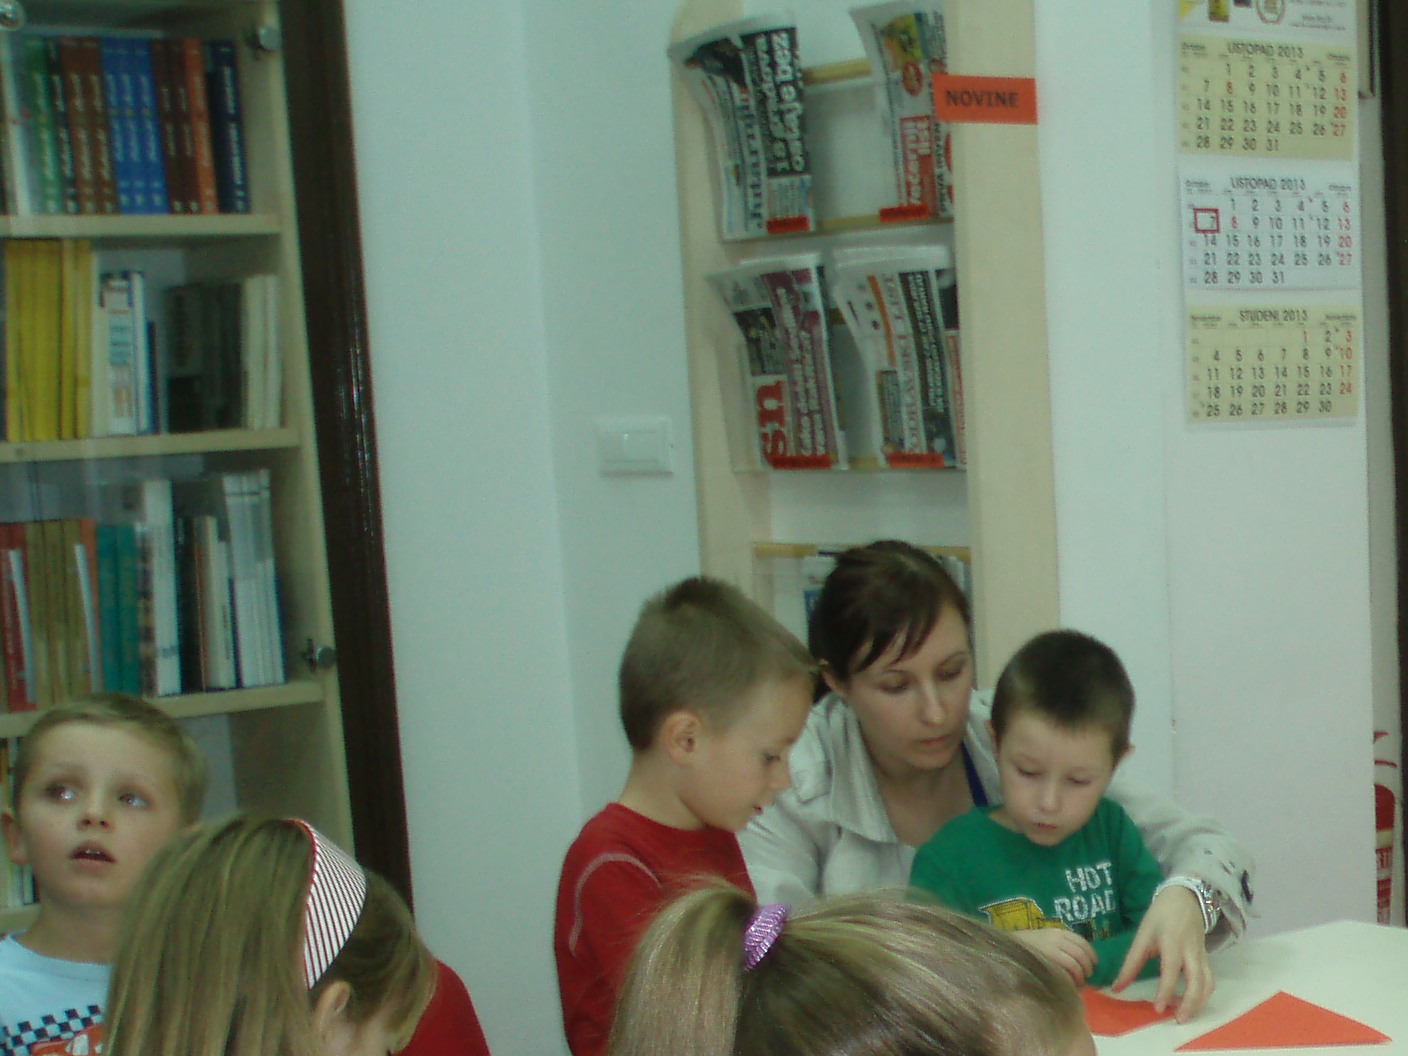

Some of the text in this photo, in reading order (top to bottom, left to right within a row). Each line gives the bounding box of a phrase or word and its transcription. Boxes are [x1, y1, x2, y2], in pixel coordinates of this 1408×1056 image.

[1228, 42, 1273, 54] LISTOPAD
[1278, 45, 1303, 59] 2013
[945, 89, 1020, 109] NOVINE
[1230, 176, 1306, 190] LISTOPAD 2013
[1240, 309, 1307, 322] STUDENI 2013
[1064, 861, 1113, 893] HOT
